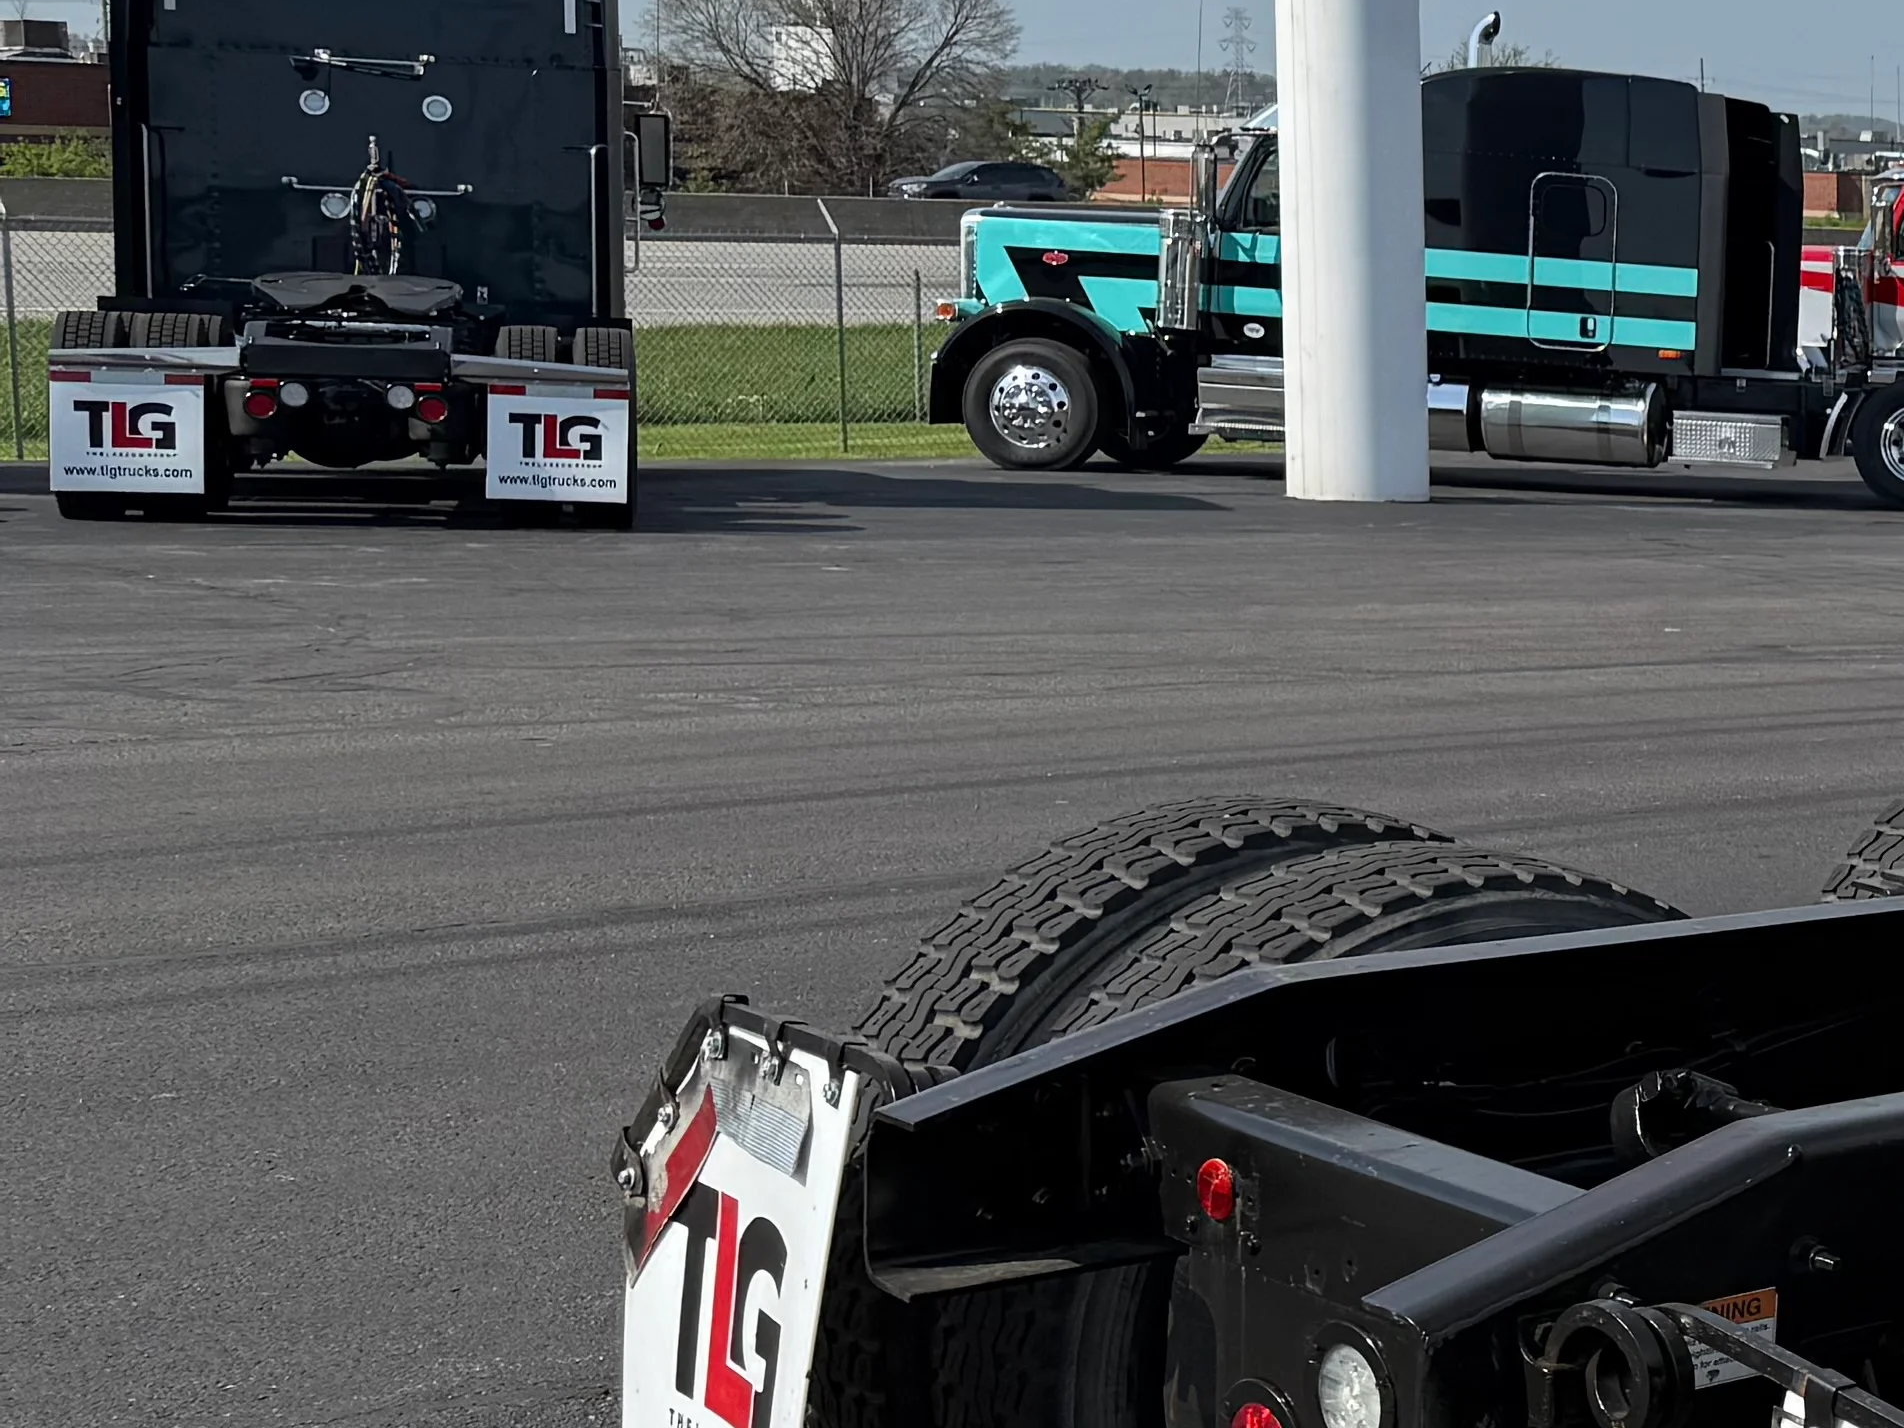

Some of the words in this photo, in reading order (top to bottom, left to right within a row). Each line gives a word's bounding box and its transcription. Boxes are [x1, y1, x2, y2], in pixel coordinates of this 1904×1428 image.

[73, 400, 176, 450] TLG
[508, 412, 603, 461] TLG
[63, 464, 193, 480] www.tlgtrucks.com
[498, 473, 617, 489] www.tlgtrucks.com
